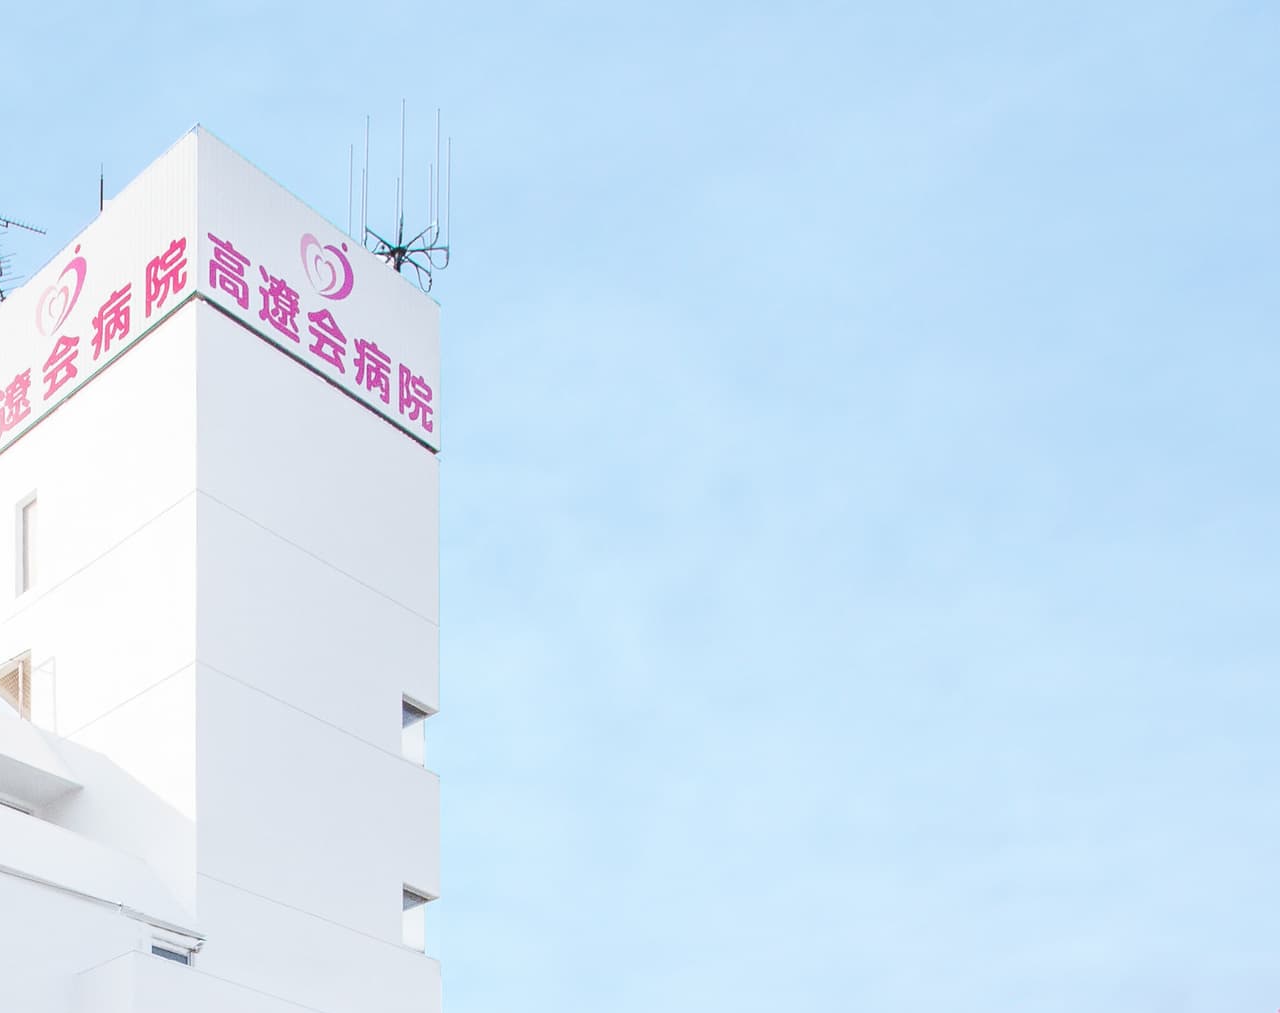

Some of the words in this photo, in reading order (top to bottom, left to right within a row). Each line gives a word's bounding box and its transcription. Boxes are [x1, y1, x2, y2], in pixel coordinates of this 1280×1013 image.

[206, 231, 434, 434] 高遼会病院
